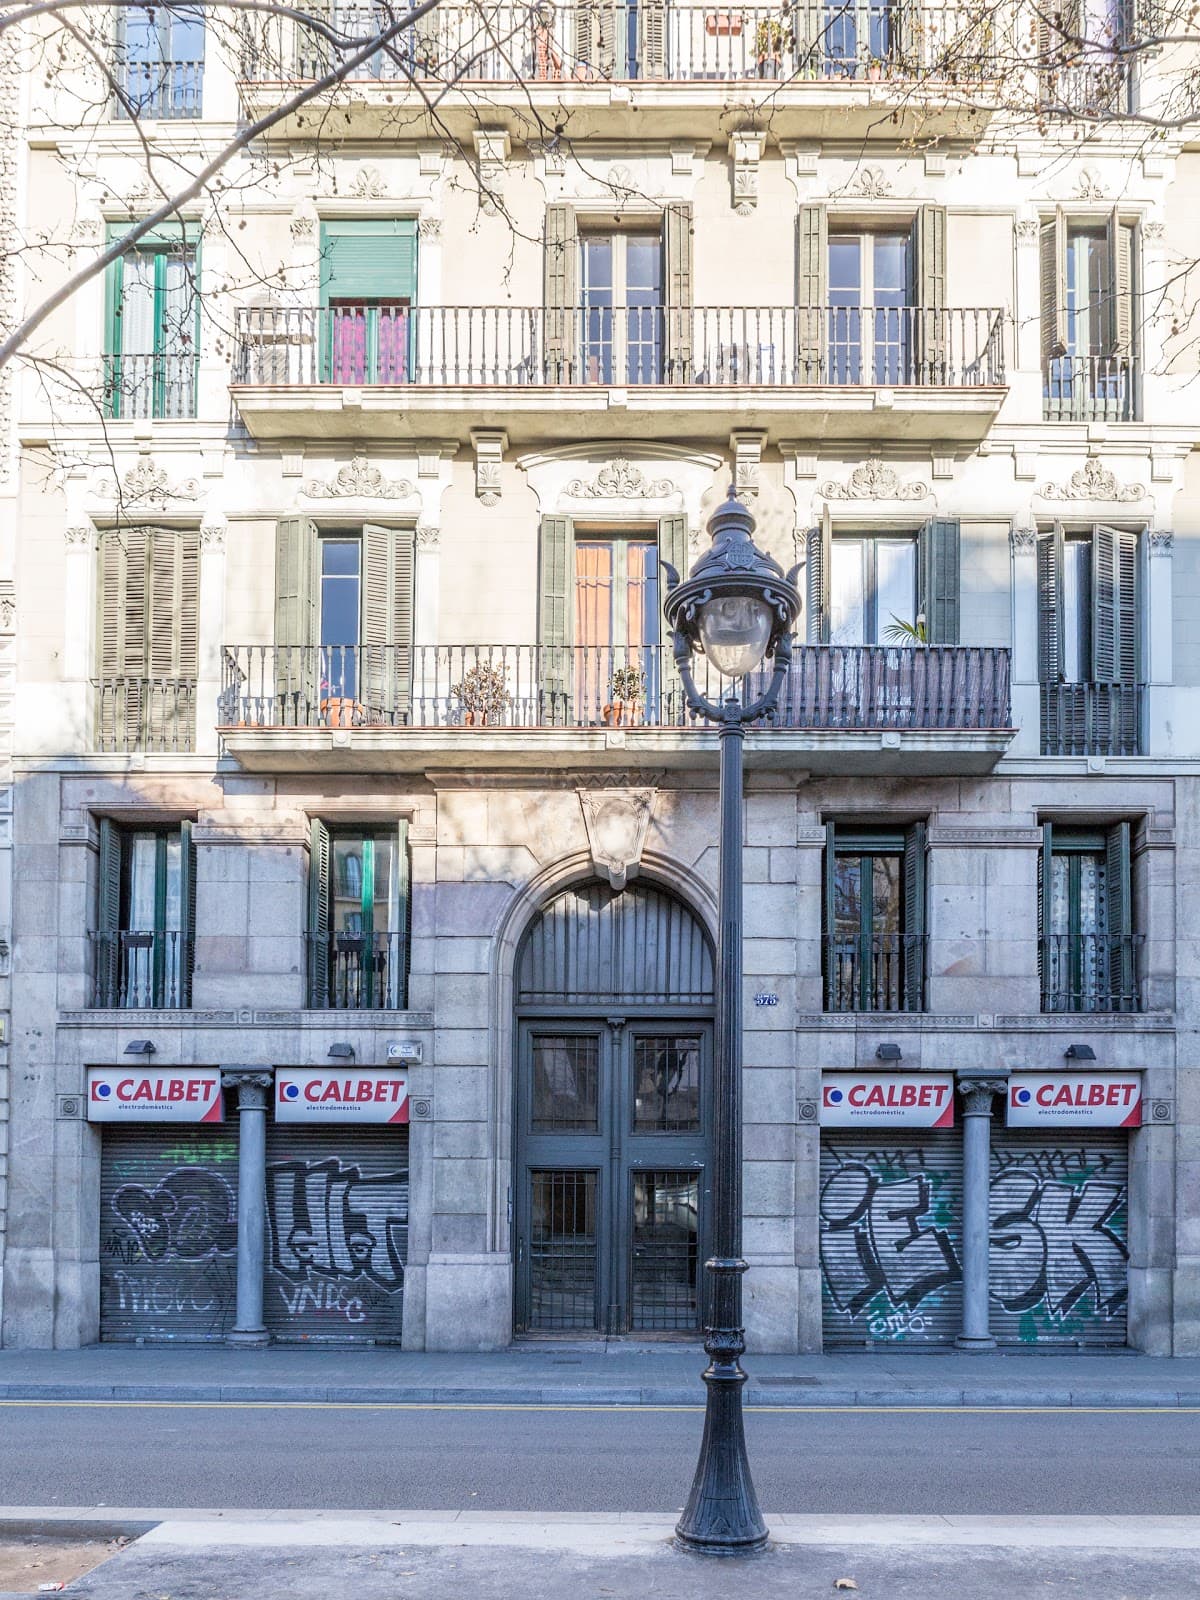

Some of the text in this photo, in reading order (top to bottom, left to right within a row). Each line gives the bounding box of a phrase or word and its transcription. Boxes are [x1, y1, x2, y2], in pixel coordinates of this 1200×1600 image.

[116, 1079, 216, 1102] CALBET
[304, 1080, 405, 1102] CALBET
[848, 1084, 949, 1107] CALBET
[1036, 1084, 1137, 1106] CALBET
